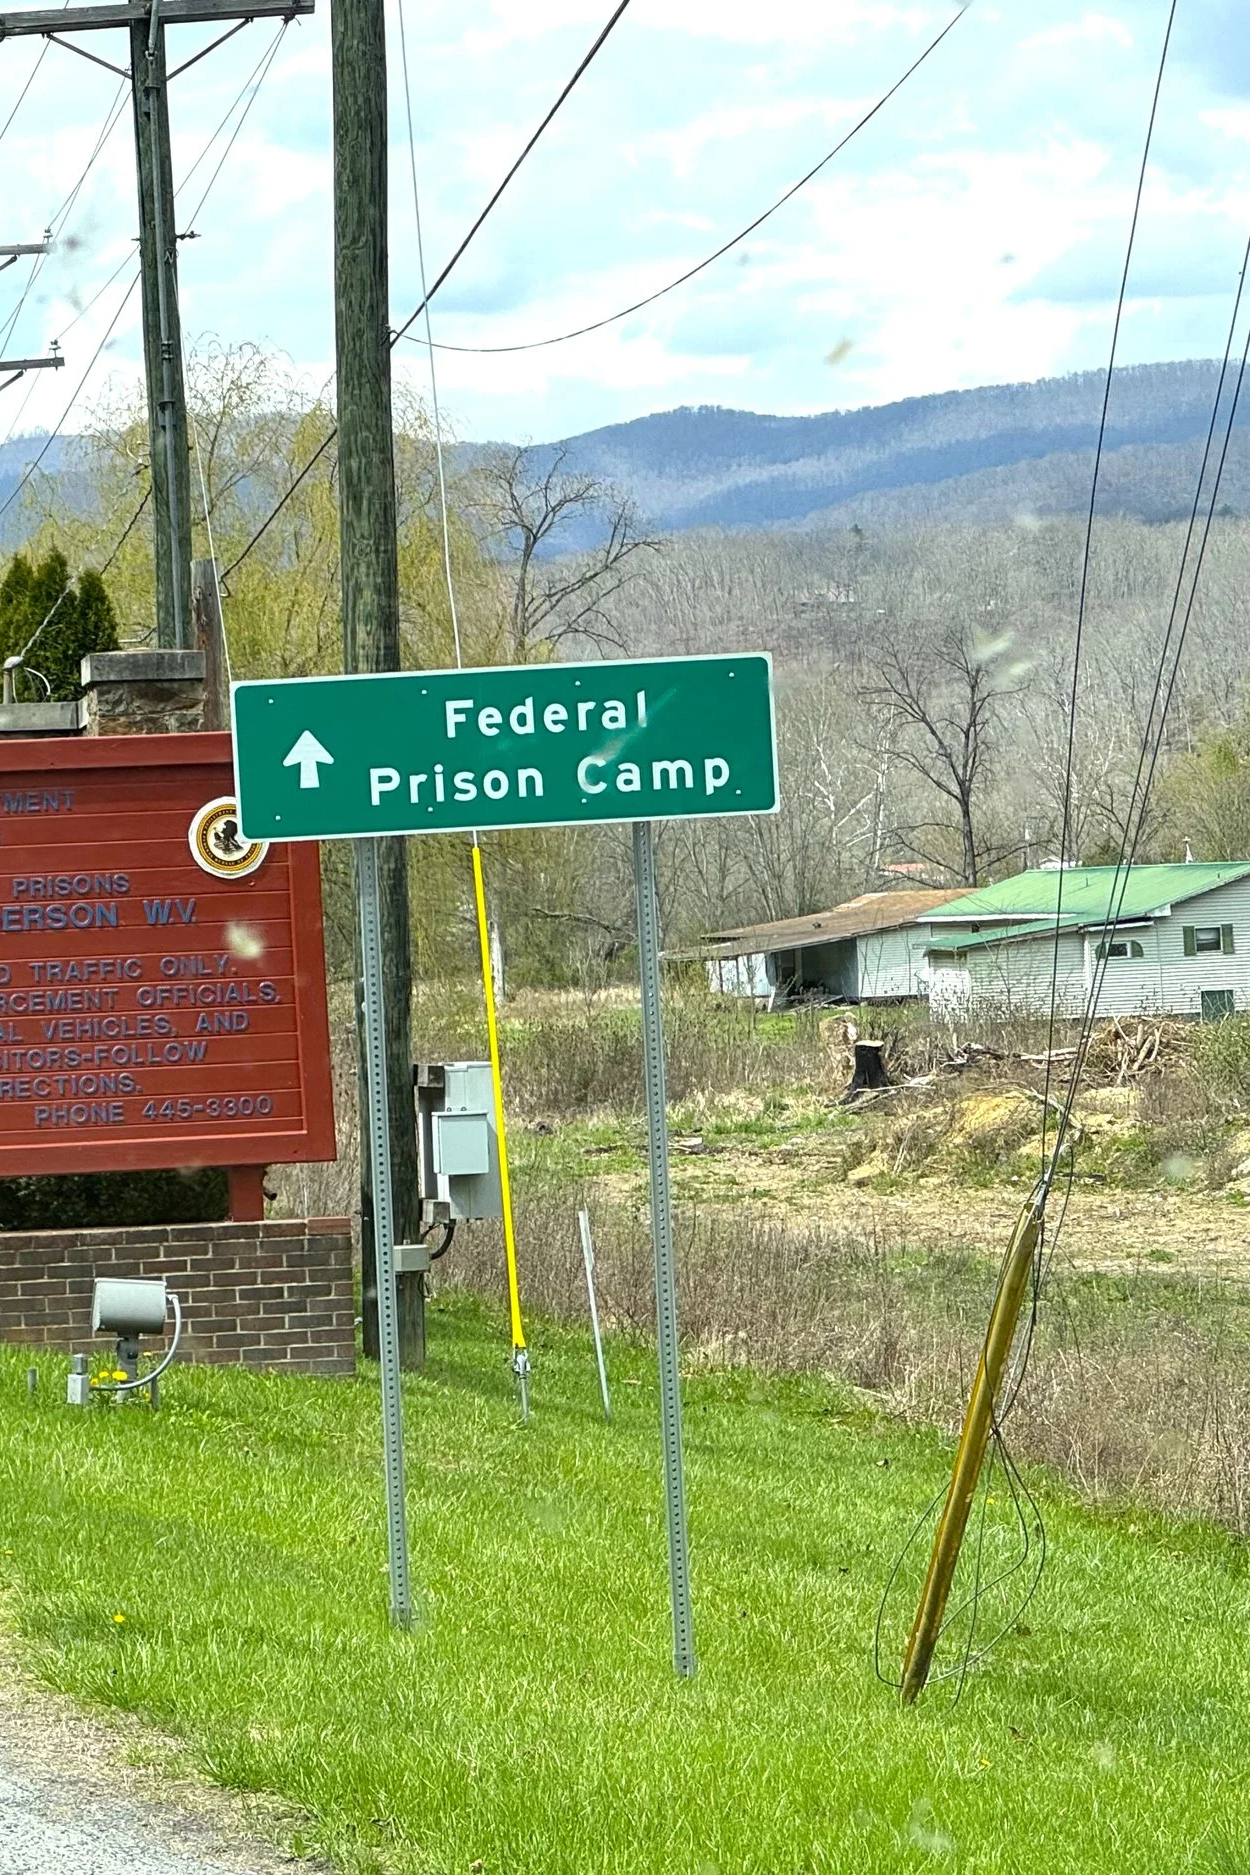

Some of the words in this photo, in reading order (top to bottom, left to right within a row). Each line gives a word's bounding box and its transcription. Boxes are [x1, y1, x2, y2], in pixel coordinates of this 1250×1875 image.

[445, 690, 648, 739] Federal
[369, 764, 544, 806] Prison
[576, 756, 731, 796] Camp
[13, 873, 131, 899] PRISONS
[142, 898, 197, 925] W.V.
[29, 958, 143, 983] TRAFFIC
[160, 954, 238, 976] ONLY.
[41, 1015, 178, 1041] VEHICLES,
[196, 1011, 250, 1033] AND
[34, 1102, 124, 1127] PHONE
[142, 1095, 273, 1120] 445-3300
